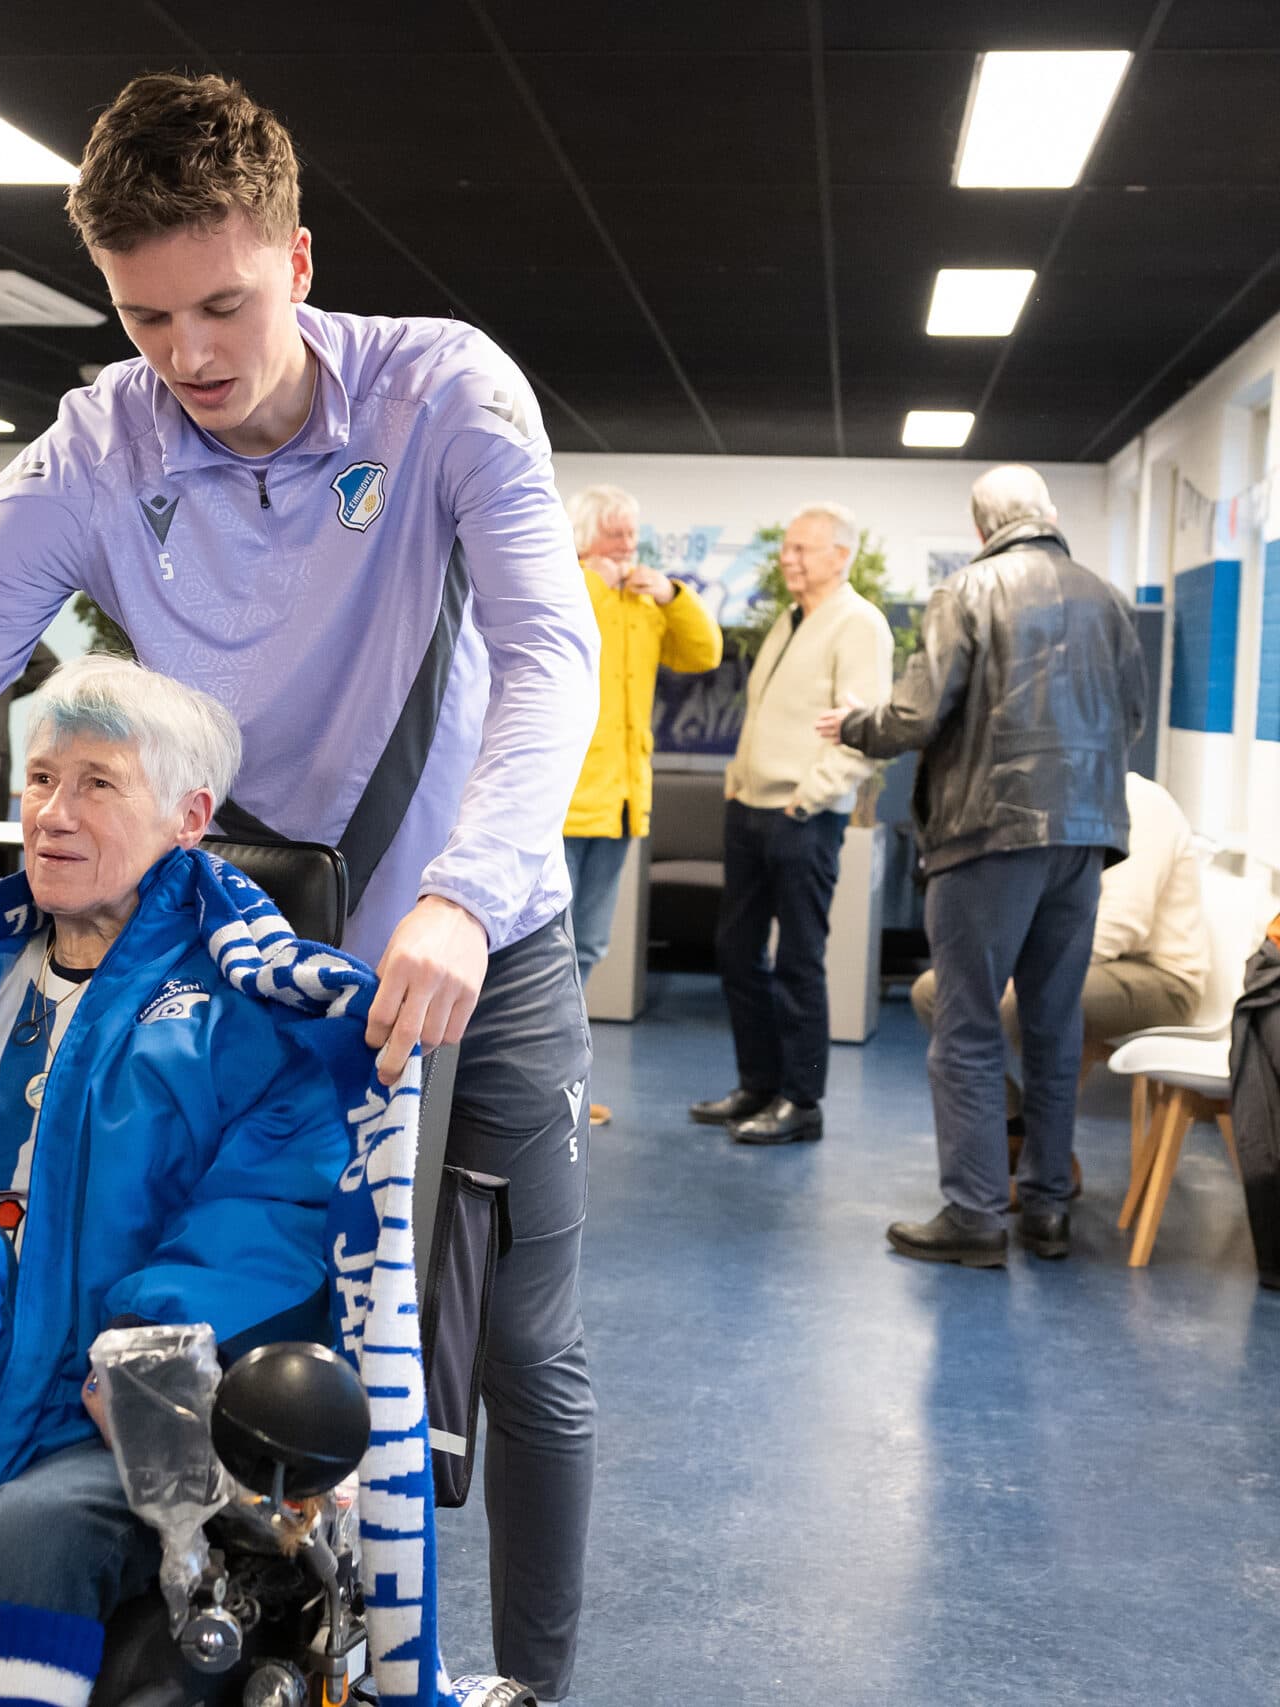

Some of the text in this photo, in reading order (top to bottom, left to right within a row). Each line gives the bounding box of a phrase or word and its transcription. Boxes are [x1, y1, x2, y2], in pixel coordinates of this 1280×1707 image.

[348, 469, 376, 509] EINDHOVEN
[158, 552, 175, 581] 5
[139, 983, 200, 1020] EINDHOVEN
[568, 1136, 579, 1163] 5
